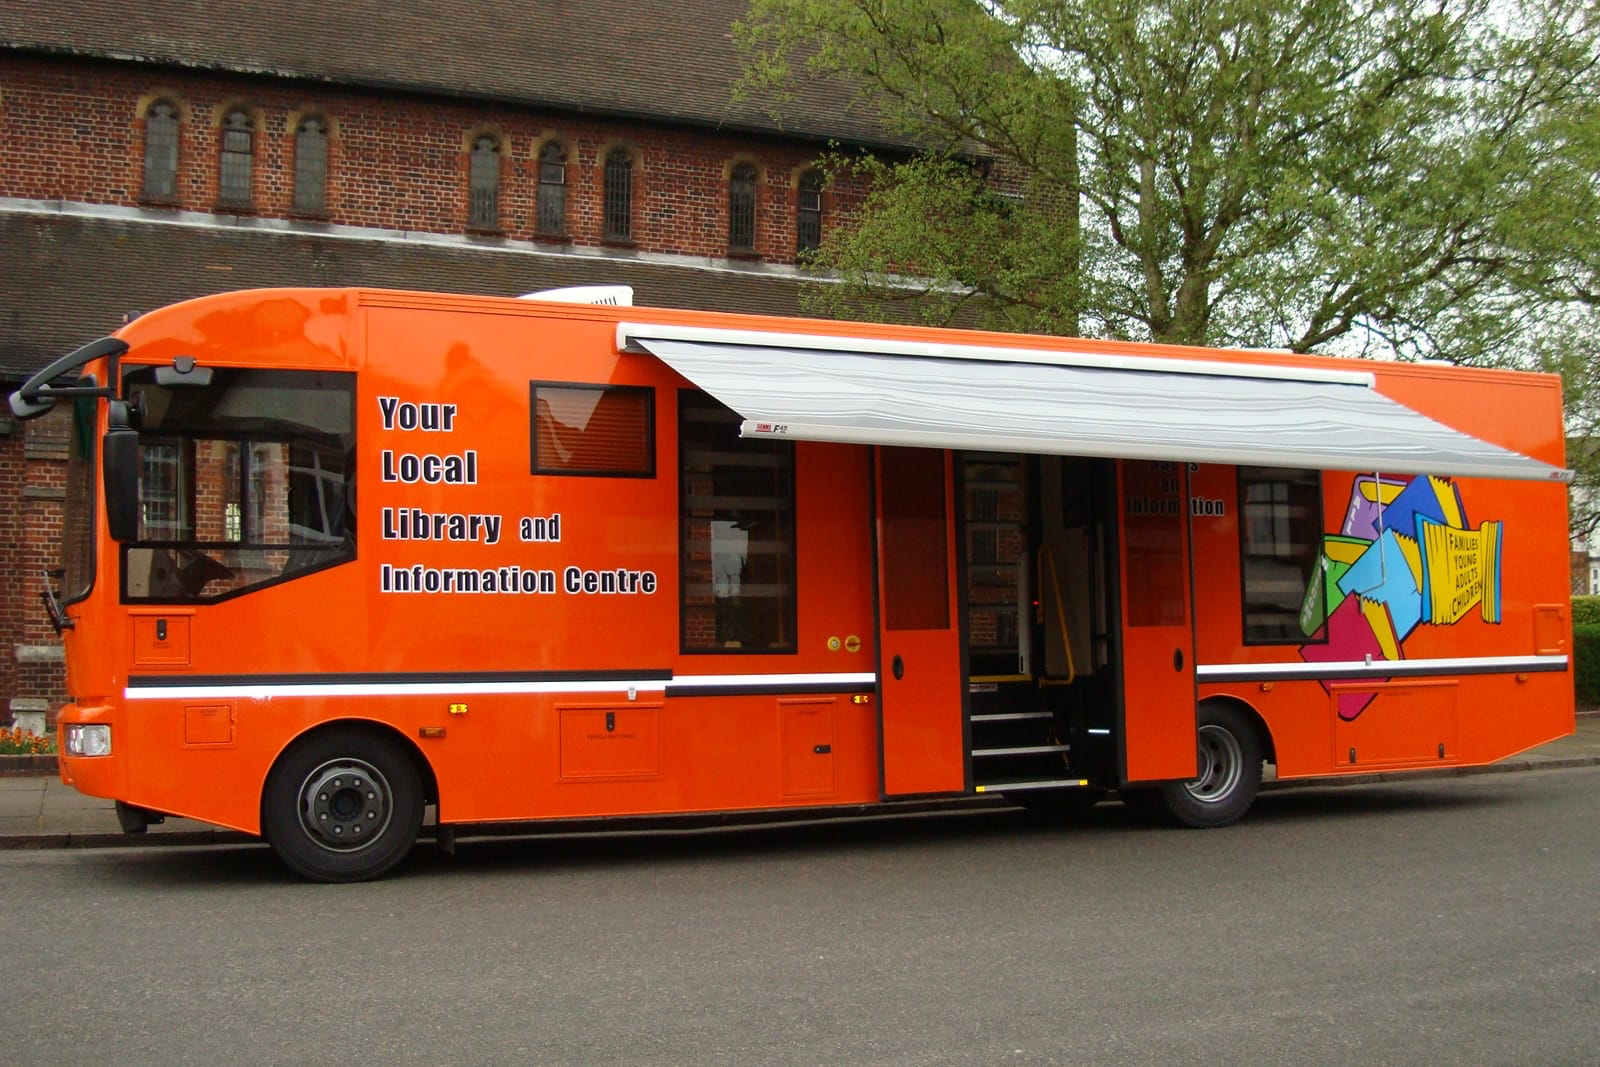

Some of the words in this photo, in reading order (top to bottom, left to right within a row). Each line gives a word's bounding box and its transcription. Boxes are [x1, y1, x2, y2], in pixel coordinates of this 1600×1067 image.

[378, 396, 457, 432] Your
[382, 450, 477, 484] Local
[1125, 495, 1225, 517] Informtion
[382, 508, 502, 545] Library
[519, 514, 561, 542] and
[1449, 533, 1479, 551] FAMILIES
[1454, 553, 1477, 571] YOUNG
[380, 564, 556, 594] Information
[564, 566, 657, 595] Centre
[1456, 567, 1478, 591] ADULTS
[1452, 580, 1482, 616] CHILDREN
